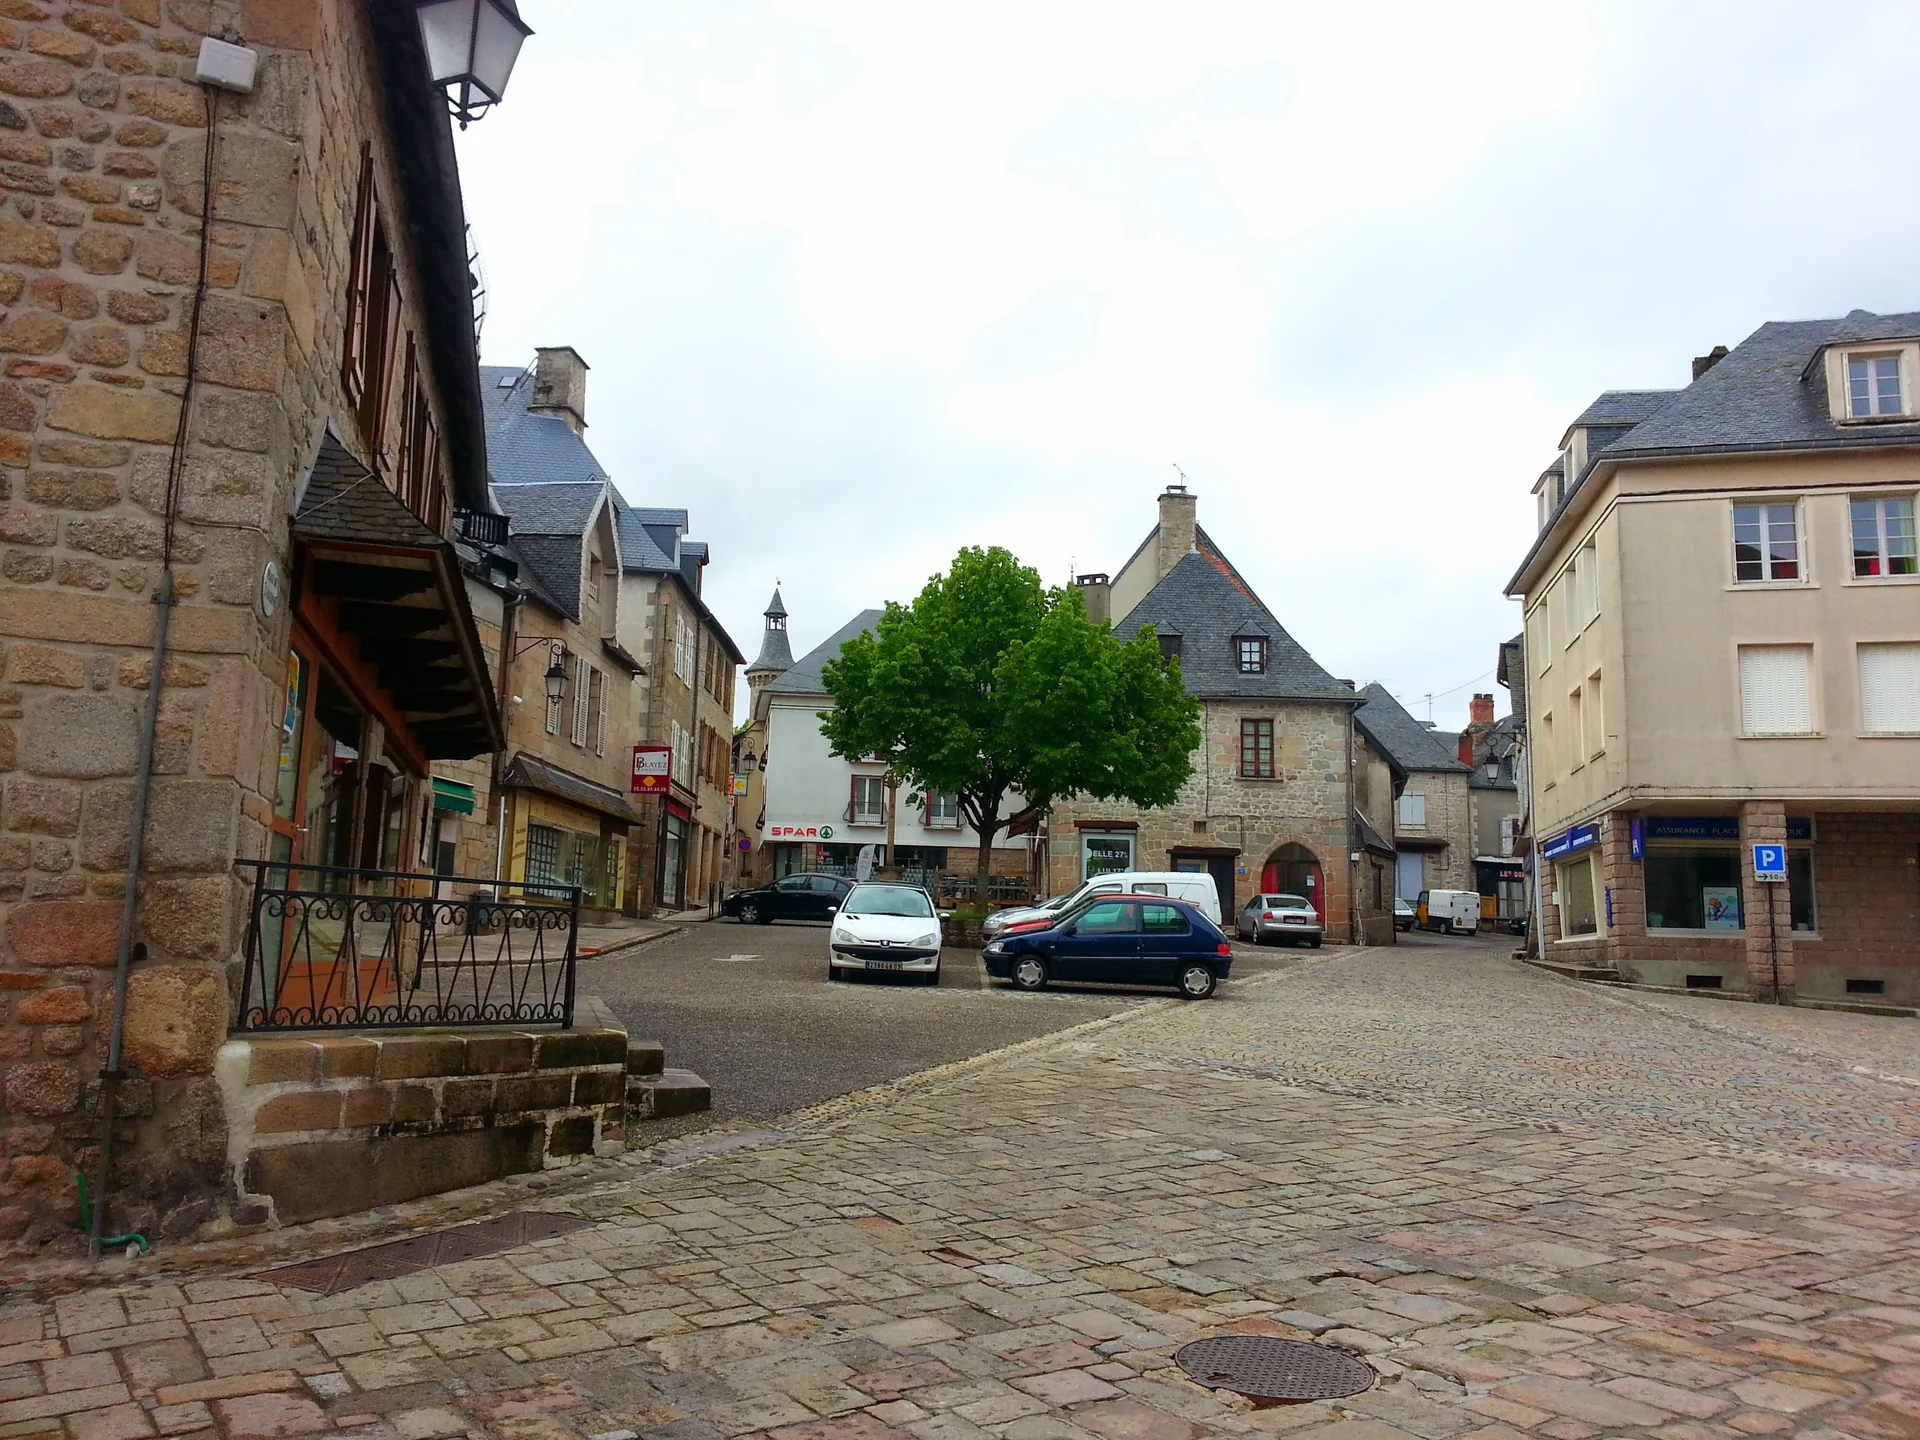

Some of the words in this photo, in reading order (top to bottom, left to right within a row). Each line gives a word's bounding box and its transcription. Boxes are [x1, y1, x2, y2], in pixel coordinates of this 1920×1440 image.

[637, 757, 667, 768] BLAYEZ
[771, 827, 817, 836] SPAR
[1093, 850, 1114, 858] ELLE
[1762, 849, 1776, 867] P
